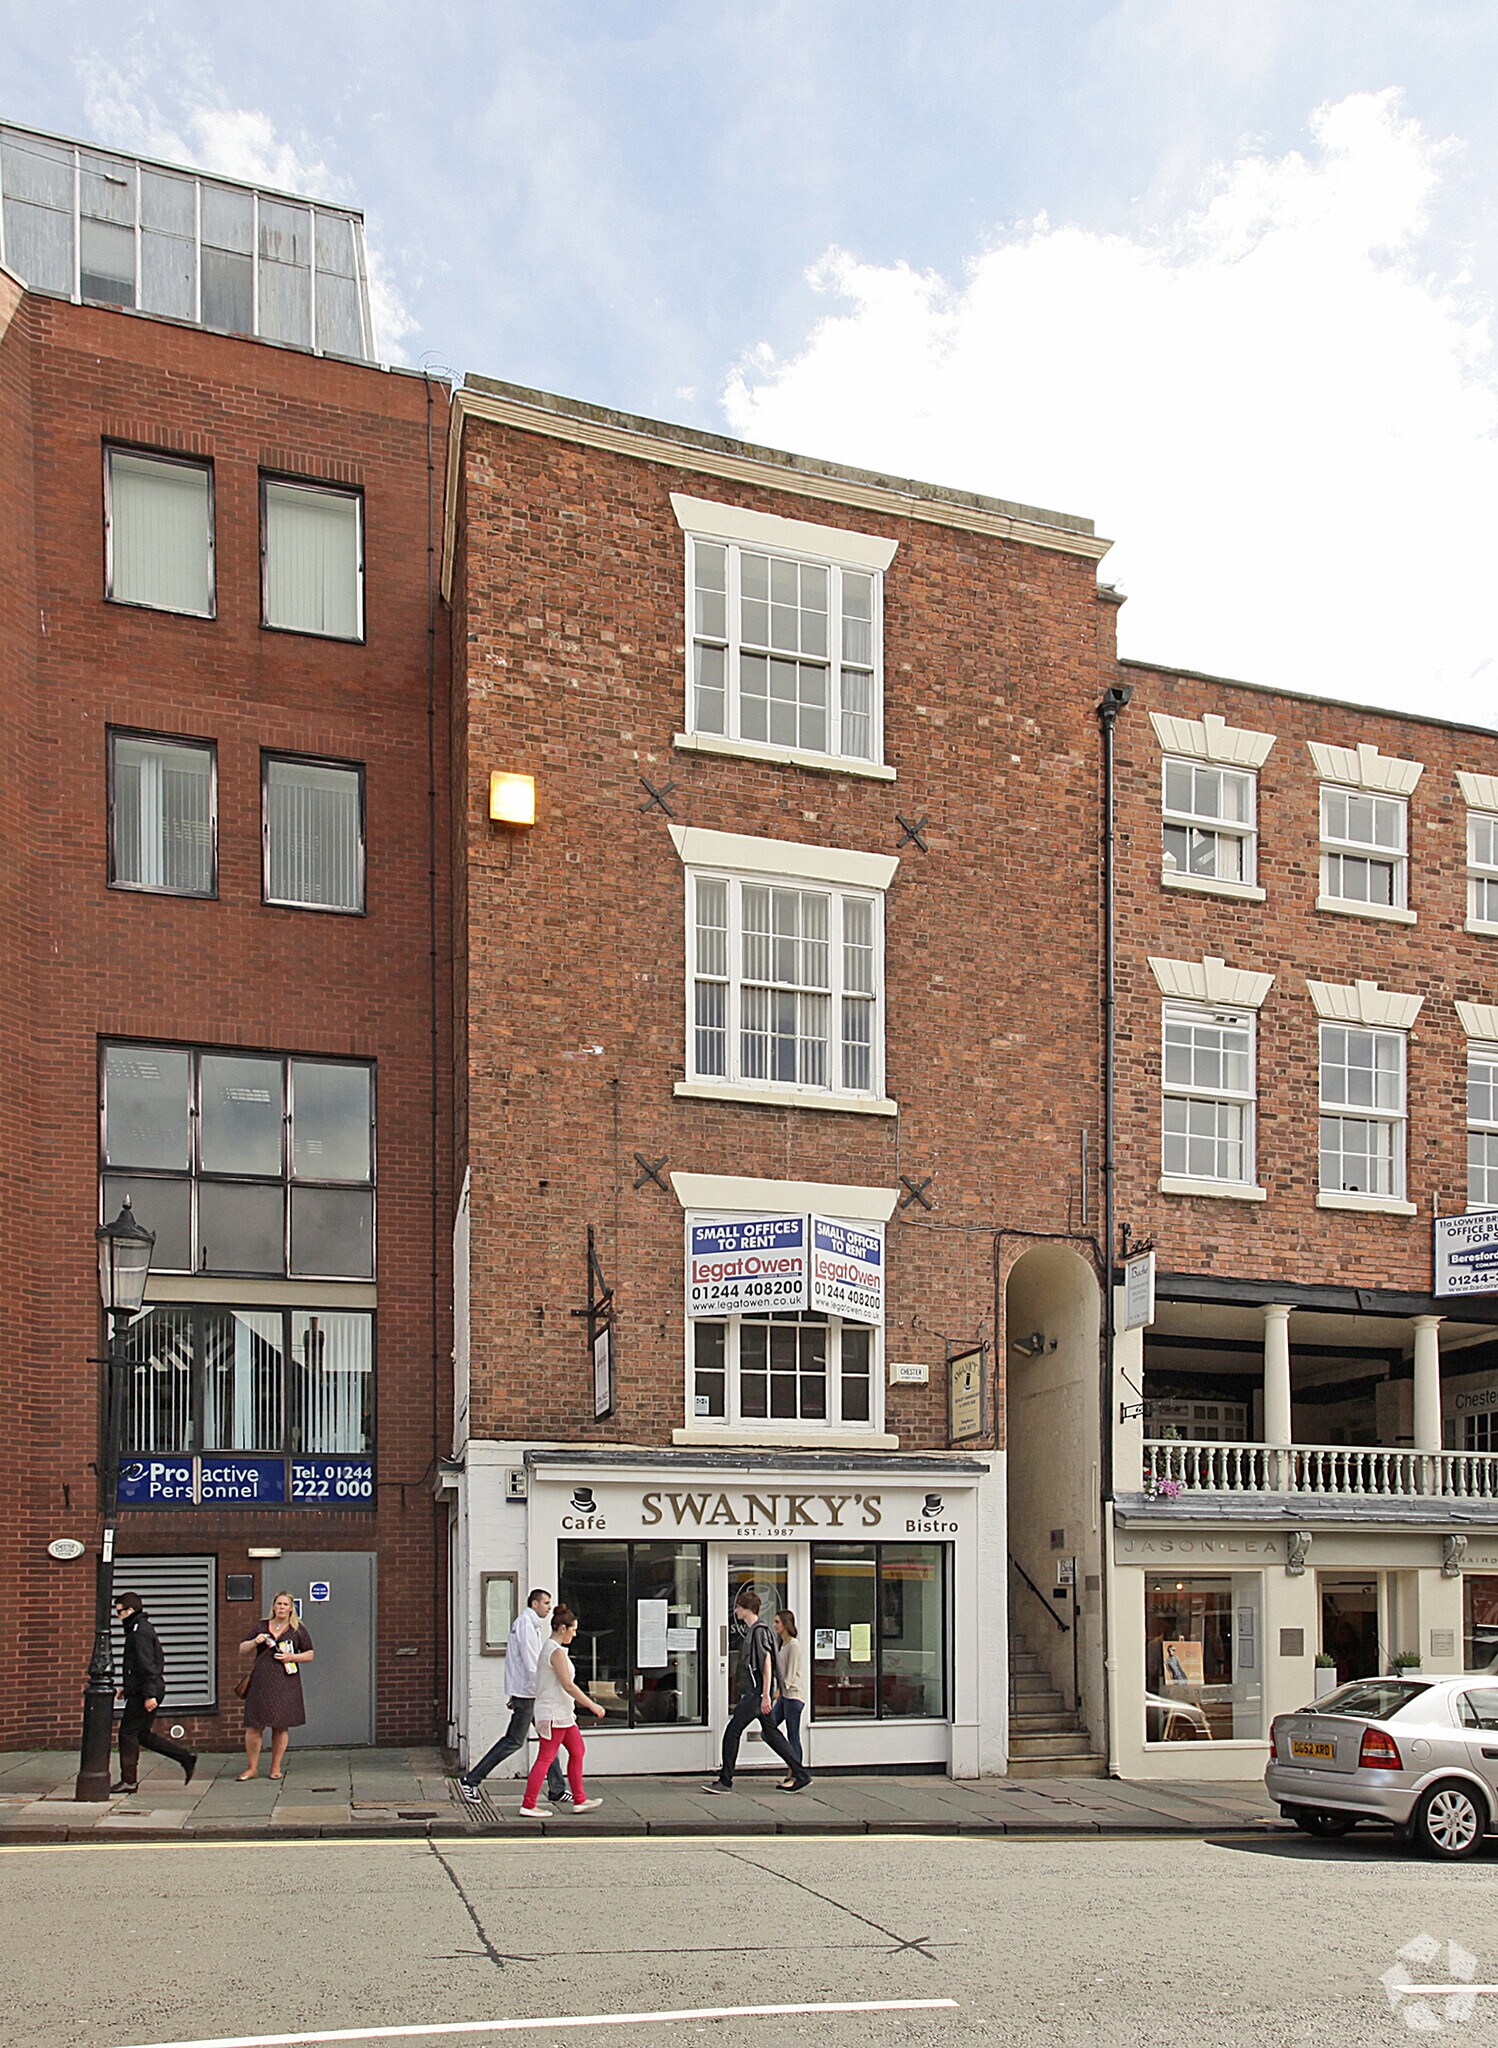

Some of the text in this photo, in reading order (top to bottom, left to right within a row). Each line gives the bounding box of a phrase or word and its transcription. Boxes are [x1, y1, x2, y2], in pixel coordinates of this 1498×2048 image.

[1454, 1217, 1484, 1226] LOWER
[1486, 1215, 1498, 1223] BR
[696, 1221, 799, 1240] SMALL OFFICES
[817, 1222, 879, 1252] SMALL OFFICES
[1448, 1225, 1484, 1237] OFFICE
[1467, 1233, 1489, 1243] FOR
[718, 1235, 776, 1250] TO RENT
[831, 1239, 867, 1259] TO RENT
[1452, 1252, 1498, 1263] Beresford
[692, 1280, 802, 1300] 01244 408200
[815, 1281, 845, 1300] 01244
[848, 1290, 880, 1310] 408200
[692, 1296, 802, 1311] www.legatowen.co.uk
[816, 1299, 880, 1320] www.legatowen.co.uk
[900, 1368, 922, 1376] CHESTER
[292, 1466, 373, 1479] Tel. 01244
[292, 1480, 373, 1497] 222 000
[641, 1493, 882, 1527] SWANKY'S
[561, 1515, 606, 1530] Café
[905, 1520, 959, 1533] Bistro
